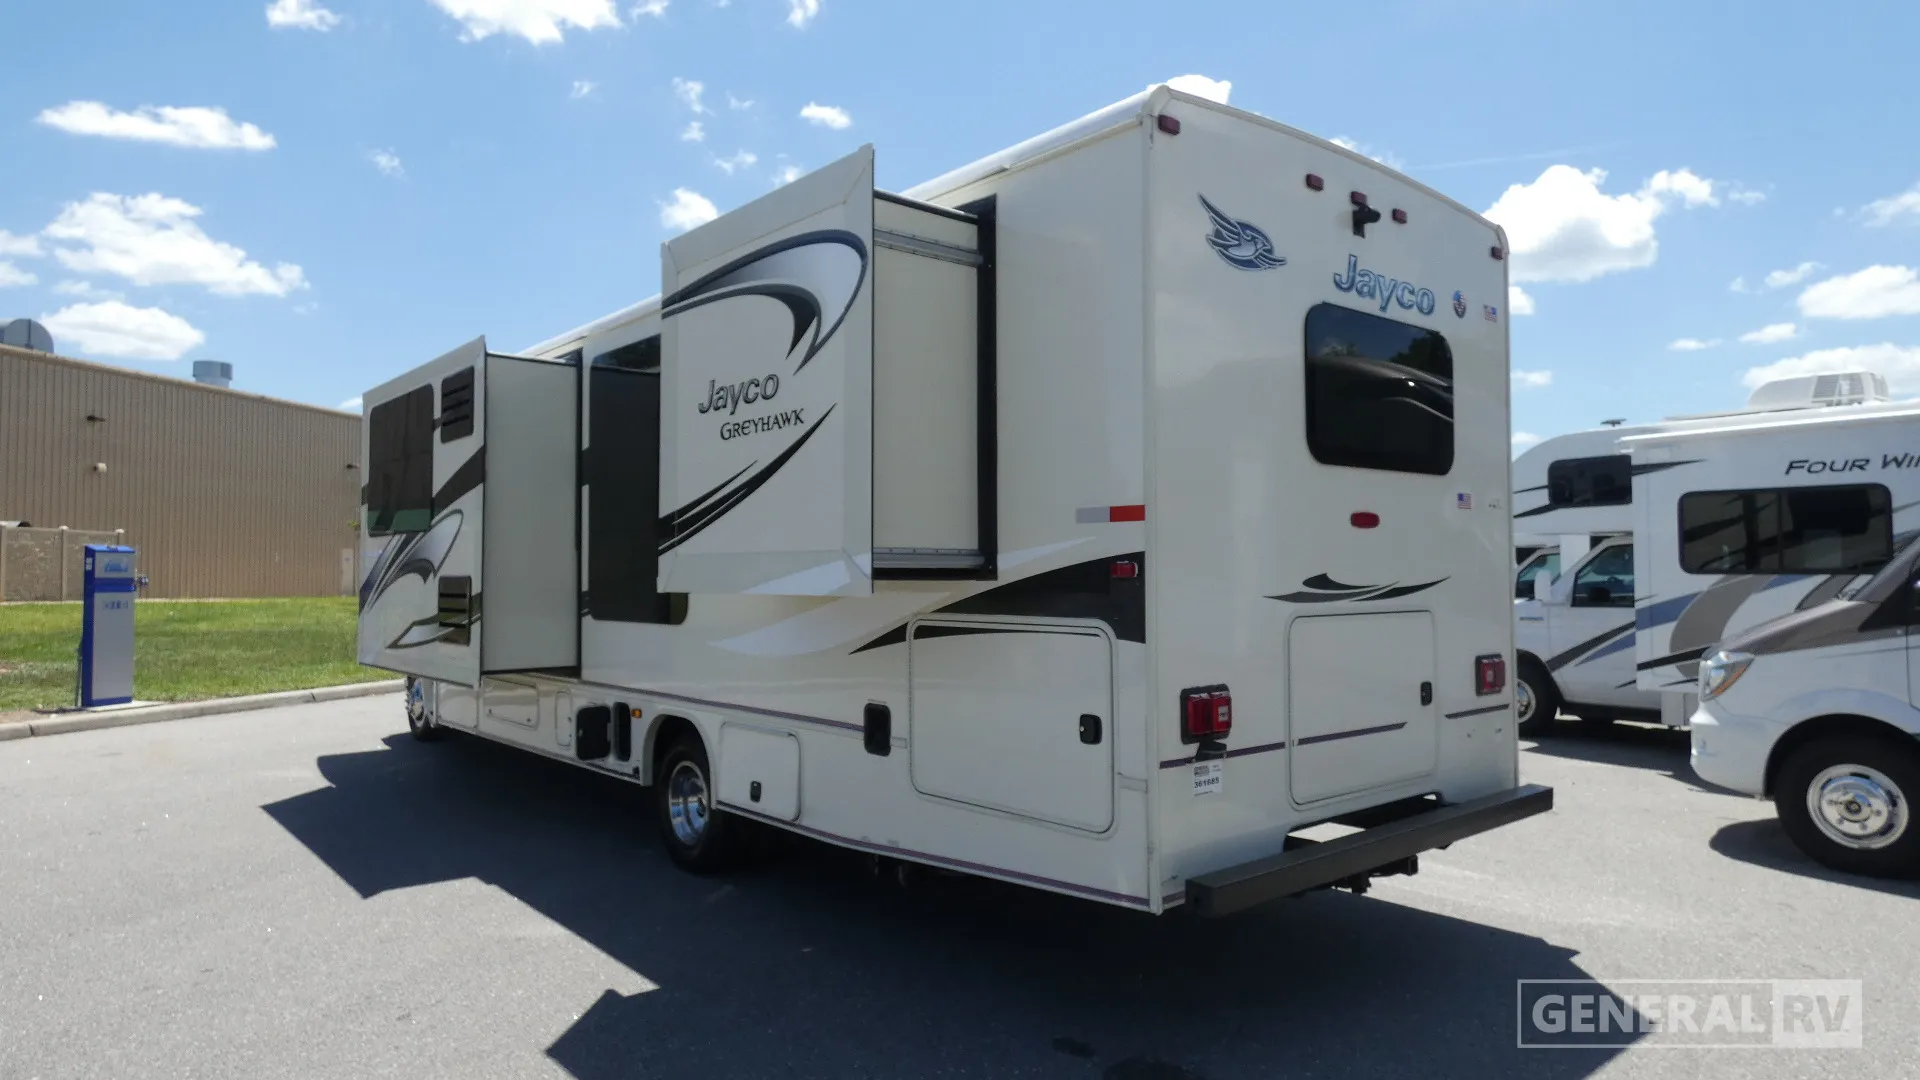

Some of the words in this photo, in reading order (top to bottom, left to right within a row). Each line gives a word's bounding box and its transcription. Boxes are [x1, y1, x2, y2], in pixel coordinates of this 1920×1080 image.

[1334, 254, 1435, 316] Jayco
[698, 374, 779, 415] Jayco
[720, 408, 804, 440] GREYHAWK
[1785, 458, 1870, 475] FOUR
